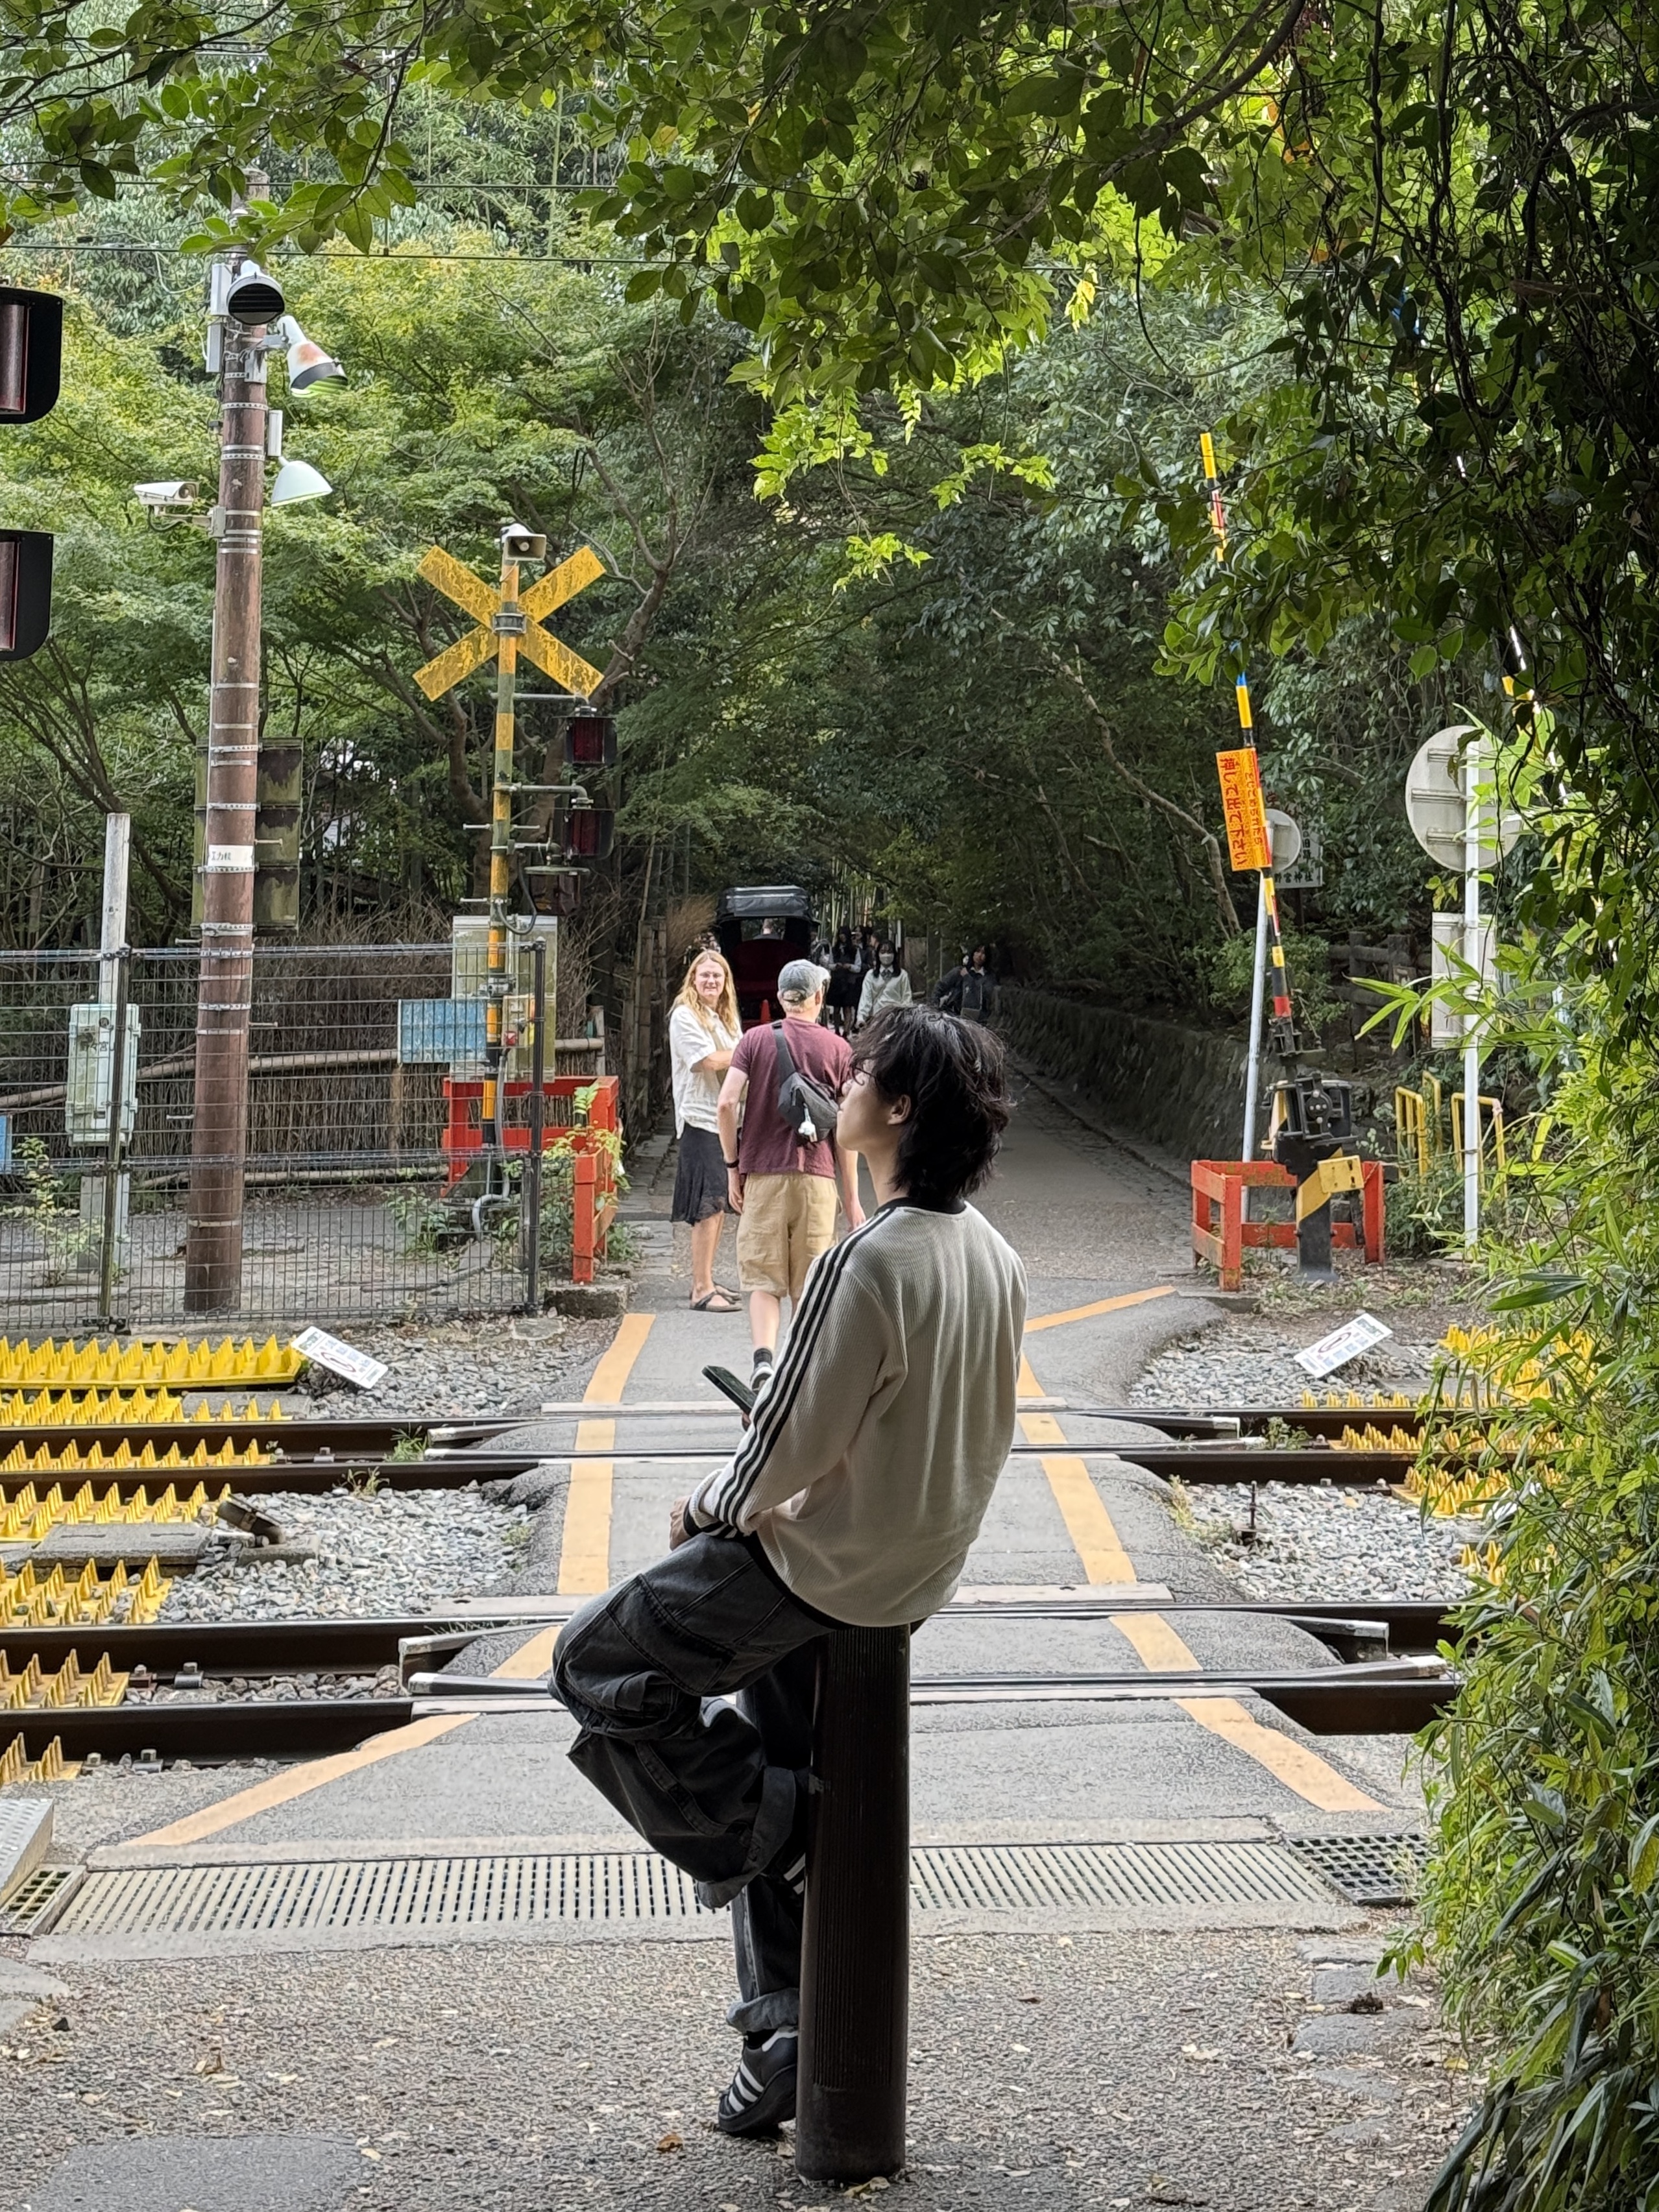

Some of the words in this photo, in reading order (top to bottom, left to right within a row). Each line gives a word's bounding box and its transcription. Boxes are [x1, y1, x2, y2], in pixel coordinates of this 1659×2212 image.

[1220, 758, 1248, 866] 押して出て下さい
[1245, 772, 1263, 845] とじこめられたら
